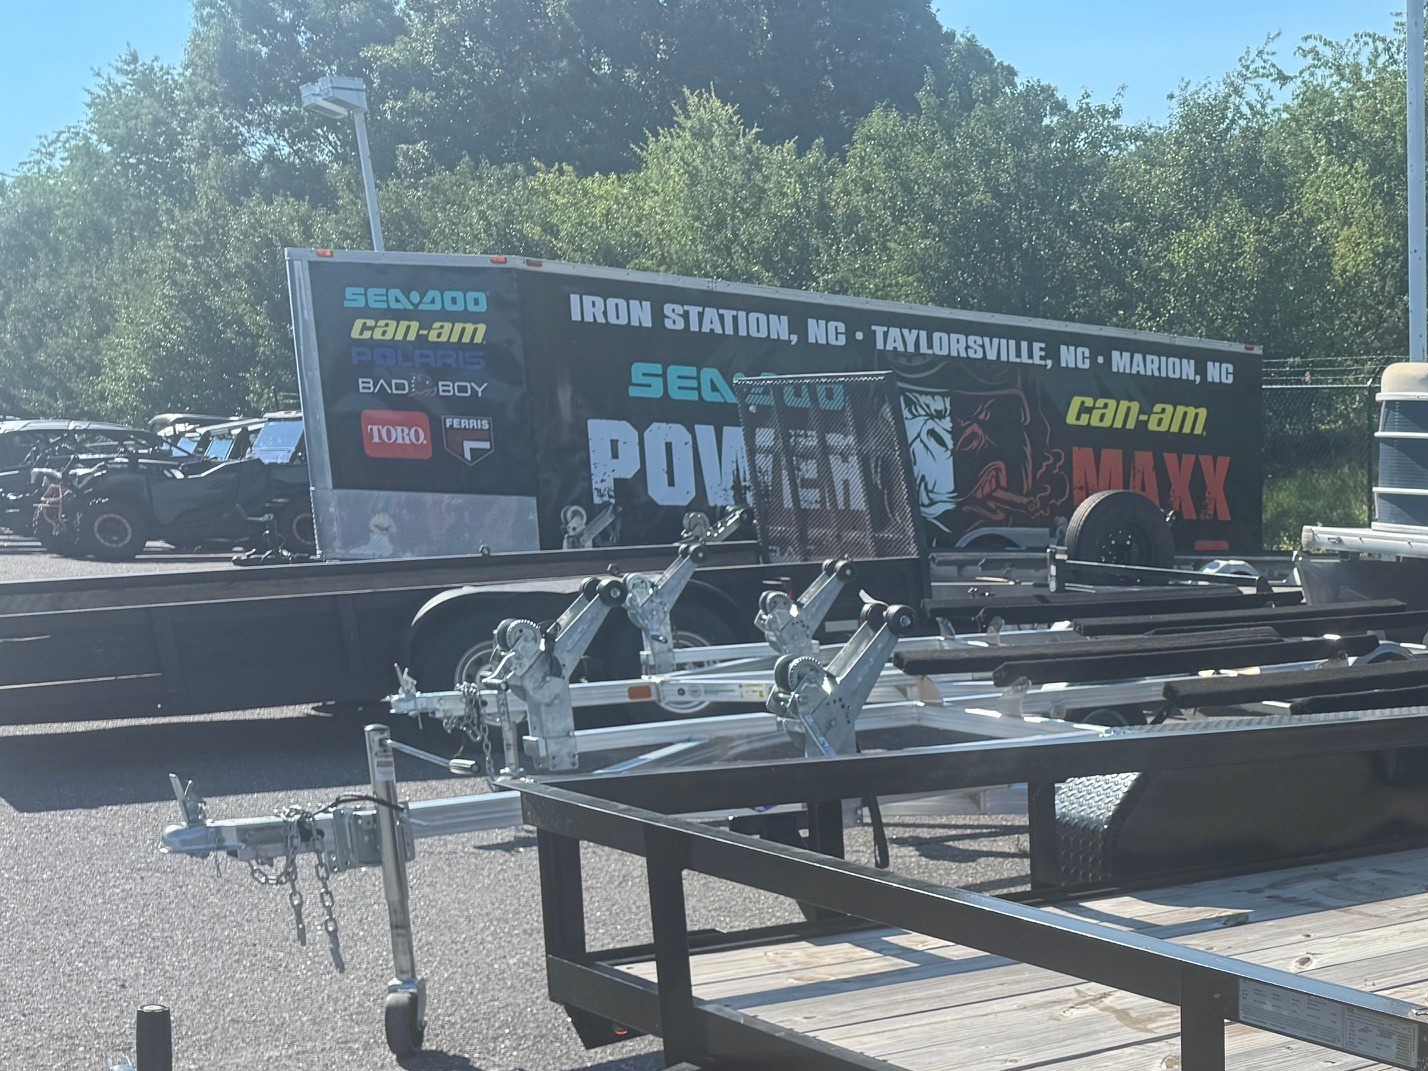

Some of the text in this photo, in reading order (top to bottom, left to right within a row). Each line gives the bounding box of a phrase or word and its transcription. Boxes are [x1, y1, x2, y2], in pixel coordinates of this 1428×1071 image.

[350, 318, 487, 344] can-am
[569, 293, 1234, 384] IRON STATION, NC TAYLORSVILLE, NC MARION, NC
[351, 345, 486, 369] POLARIS
[358, 378, 488, 397] BAD BOY
[445, 418, 490, 430] FERRIS
[1065, 395, 1208, 436] can-am
[1072, 446, 1231, 520] MAXX
